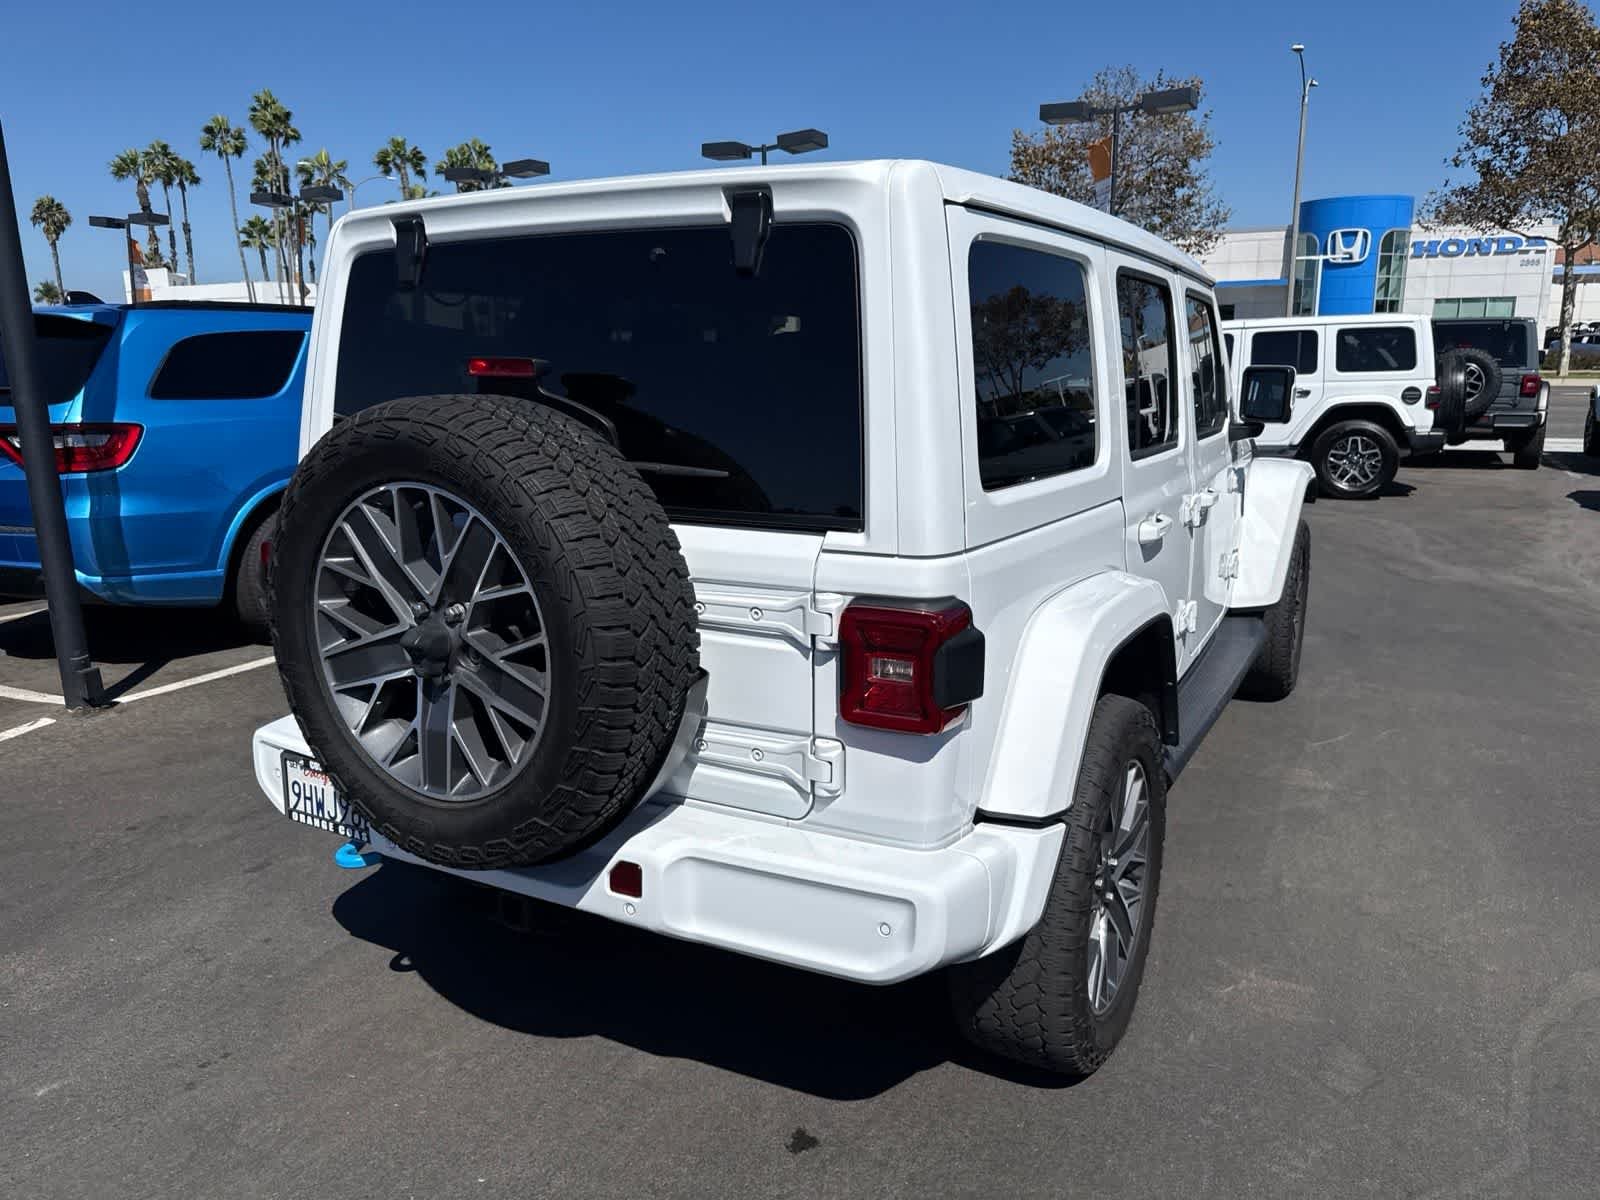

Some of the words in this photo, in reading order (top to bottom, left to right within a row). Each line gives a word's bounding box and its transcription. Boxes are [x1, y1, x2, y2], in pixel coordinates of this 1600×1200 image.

[1411, 236, 1548, 258] HONDA
[291, 780, 369, 828] 9HWJ9
[292, 811, 335, 833] ORANGE
[338, 825, 369, 842] COAS
